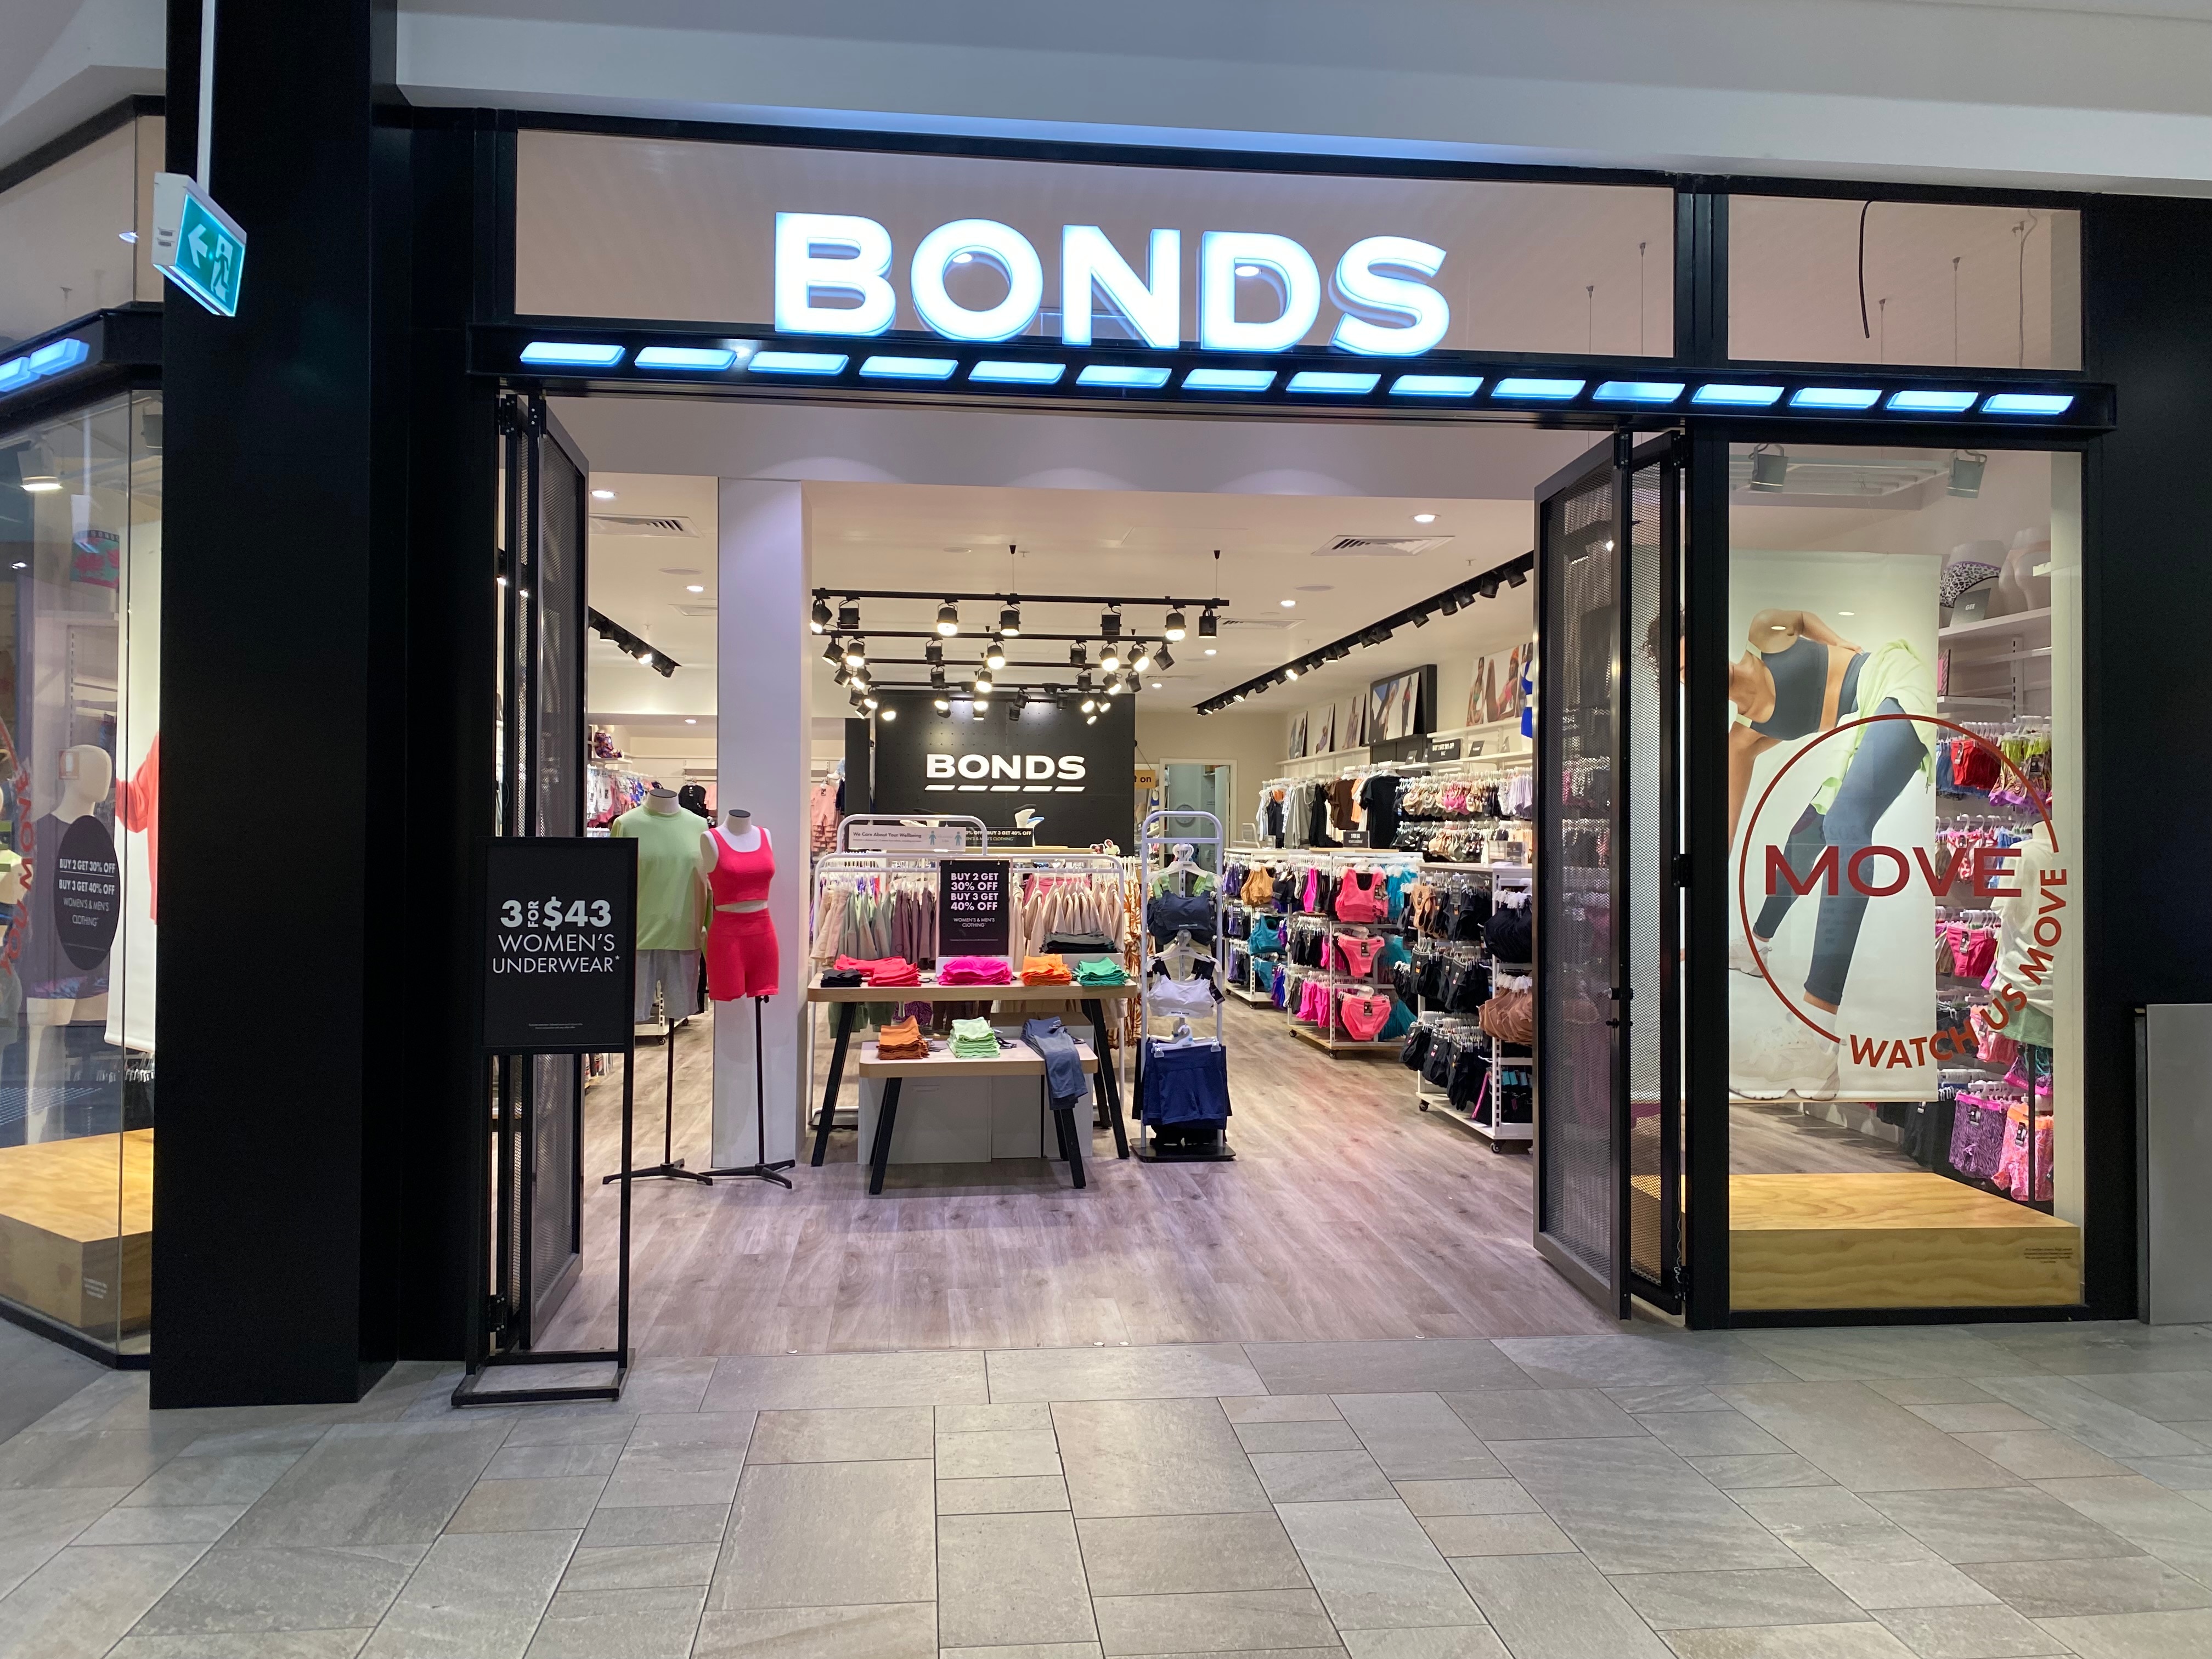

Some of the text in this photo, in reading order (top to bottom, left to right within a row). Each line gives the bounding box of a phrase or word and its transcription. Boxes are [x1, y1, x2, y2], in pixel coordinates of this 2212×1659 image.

[775, 212, 1450, 356] BONDS
[926, 753, 1086, 781] BONDS
[15, 770, 34, 891] MOVE
[59, 858, 115, 873] BUY 2 GET 30% OFF
[1765, 844, 2022, 898] MOVE
[59, 879, 115, 895] BUY 3 GET 40% OFF
[951, 882, 998, 890] 30% OFF
[63, 897, 109, 911] WOMEN'S & MEN'S
[500, 896, 612, 931] 3 FOR $43
[950, 901, 998, 910] 40% OFF
[498, 934, 615, 952] WOMEN'S
[1850, 868, 2067, 1069] WATCH US MOVE
